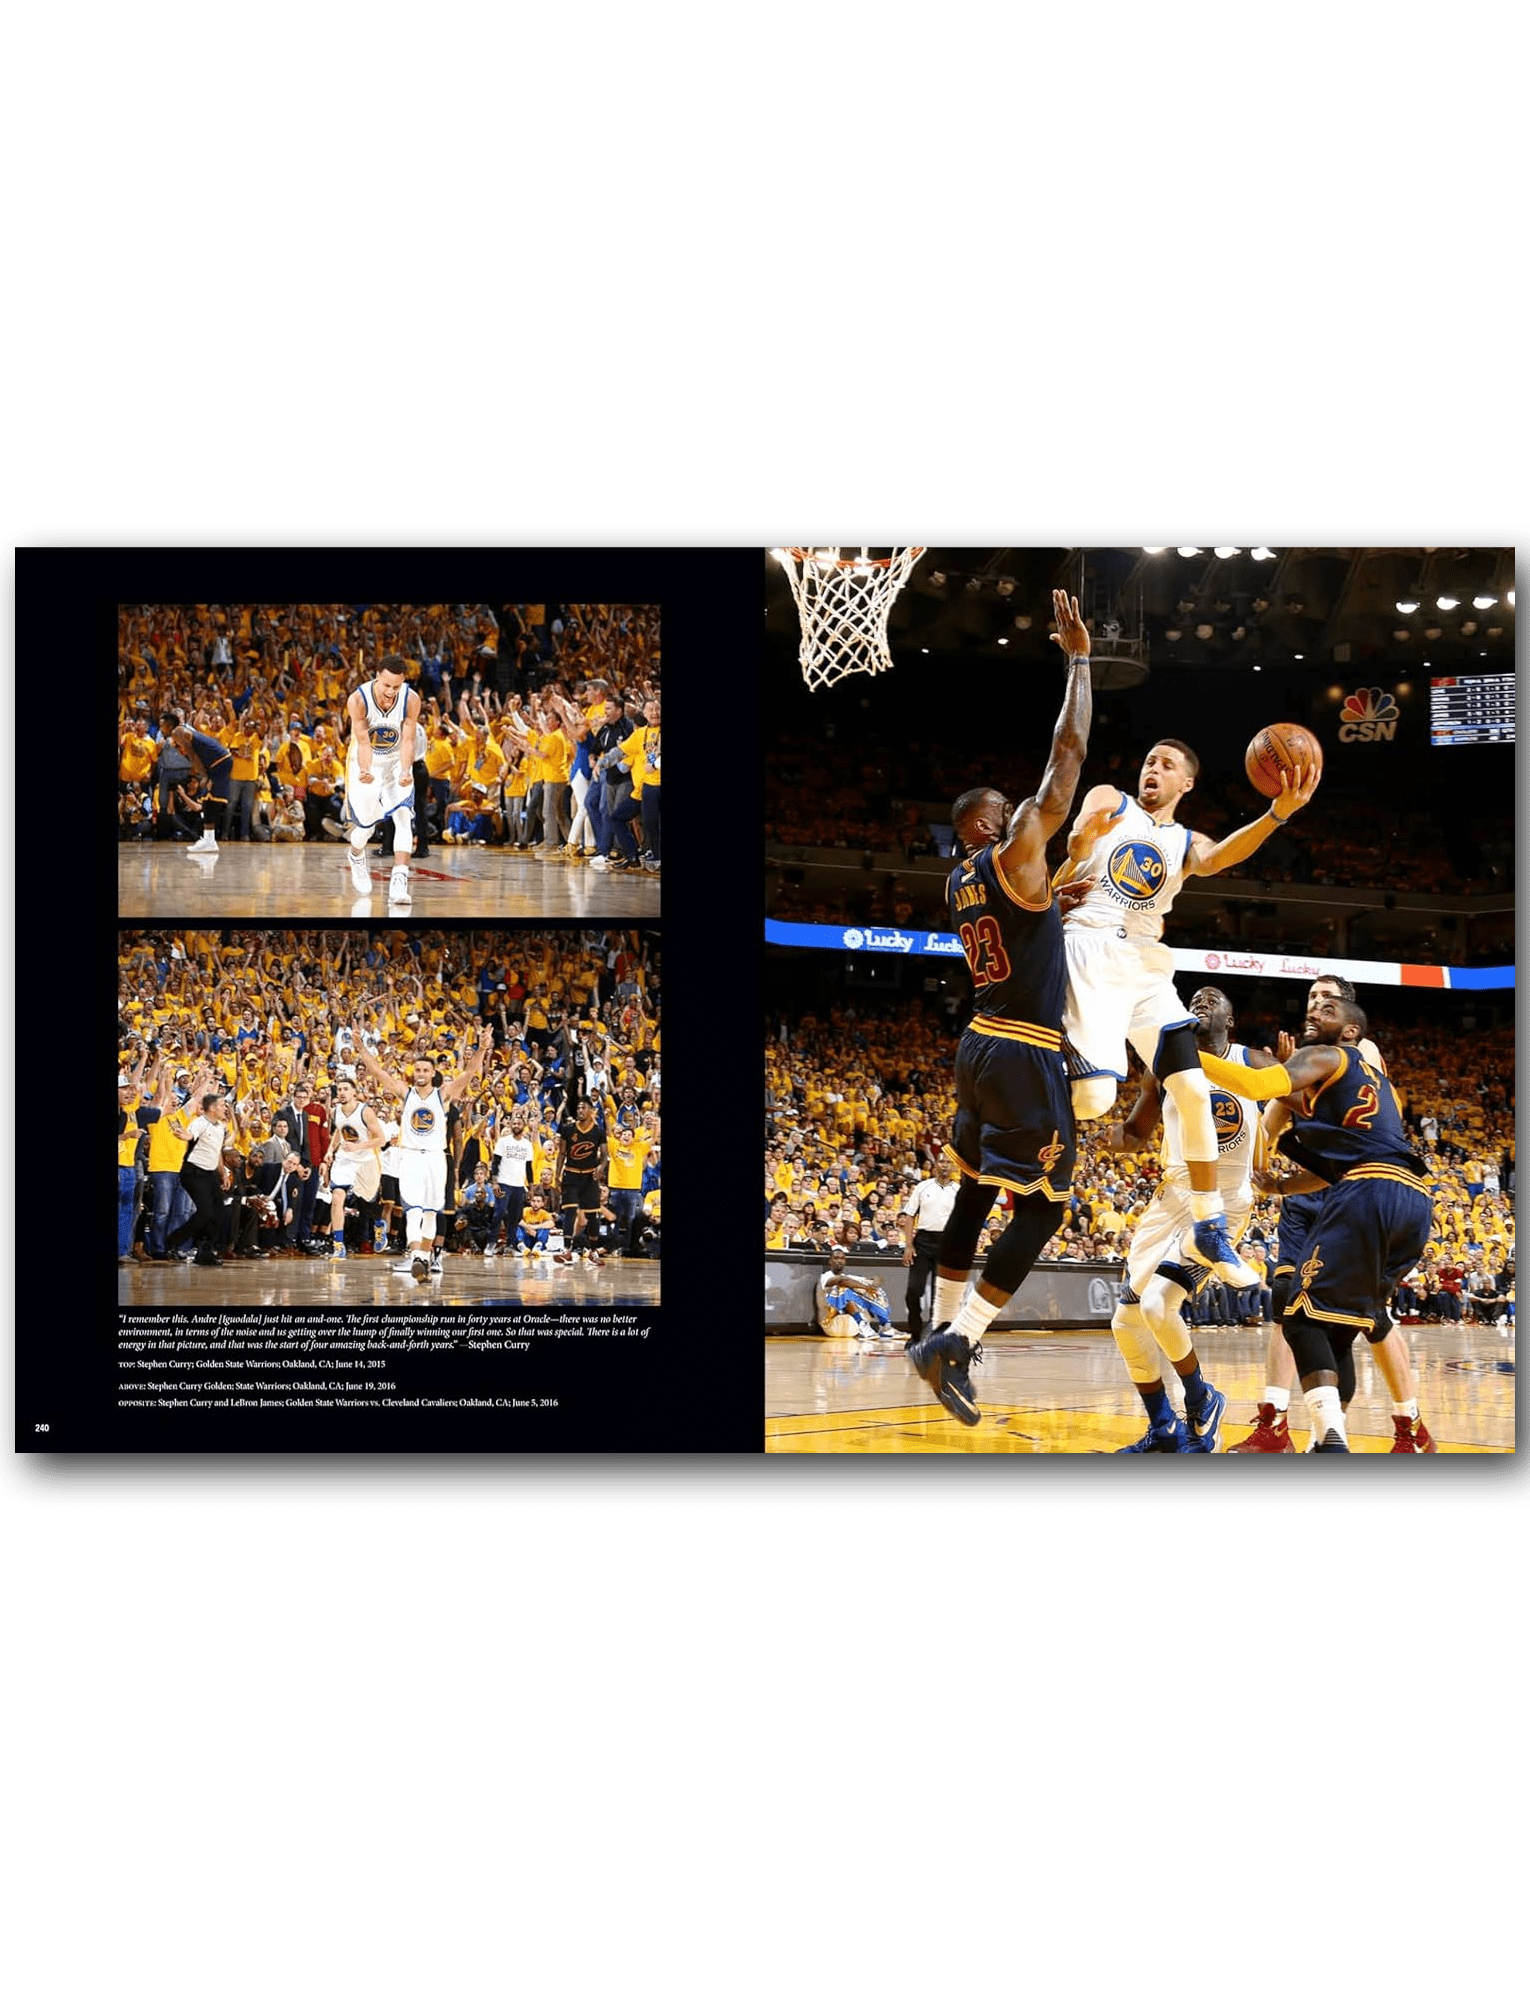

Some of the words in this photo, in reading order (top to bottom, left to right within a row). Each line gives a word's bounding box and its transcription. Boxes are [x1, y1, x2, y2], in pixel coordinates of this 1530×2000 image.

[382, 730, 395, 739] 30
[1338, 721, 1398, 743] CSN
[1139, 856, 1163, 878] 30
[1098, 874, 1156, 912] WARRIORS
[864, 929, 915, 953] Lucky
[923, 933, 964, 953] Luck
[959, 915, 1012, 988] 23
[1223, 953, 1265, 973] Lucky
[1214, 1101, 1237, 1117] 23
[1342, 1083, 1379, 1130] 2
[1217, 1130, 1247, 1154] RIORS
[128, 1314, 170, 1323] remember
[172, 1314, 189, 1323] this.
[191, 1314, 217, 1323] Andre
[262, 1315, 279, 1326] just
[281, 1314, 292, 1323] hit
[307, 1314, 343, 1323] and-one.
[346, 1314, 361, 1323] The
[362, 1314, 379, 1325] first
[381, 1314, 438, 1325] championship
[457, 1315, 466, 1323] in
[467, 1314, 488, 1325] forty
[489, 1317, 511, 1325] years
[613, 1314, 637, 1323] better
[118, 1328, 172, 1336] environment,
[175, 1328, 183, 1336] in
[210, 1327, 220, 1338] of
[220, 1327, 234, 1336] the
[236, 1328, 257, 1336] noise
[259, 1327, 276, 1336] and
[287, 1328, 316, 1338] getting
[338, 1327, 351, 1336] the
[353, 1327, 377, 1338] hump
[379, 1327, 388, 1338] of
[388, 1327, 415, 1338] finally
[417, 1328, 450, 1339] winning
[466, 1327, 484, 1338] first
[505, 1327, 516, 1336] So
[518, 1327, 535, 1336] that
[554, 1327, 584, 1338] special.
[587, 1327, 610, 1336] There
[612, 1328, 618, 1336] is
[628, 1327, 638, 1336] lot
[641, 1327, 651, 1338] of
[118, 1342, 146, 1351] energy
[159, 1340, 175, 1348] that
[177, 1341, 208, 1351] picture,
[210, 1340, 226, 1348] and
[228, 1340, 245, 1348] that
[265, 1340, 278, 1348] the
[301, 1340, 311, 1351] of
[310, 1340, 329, 1350] four
[330, 1341, 366, 1351] amazing
[367, 1340, 429, 1351] back-and-forth
[504, 1340, 530, 1351] Curry
[137, 1360, 167, 1370] Stephen
[196, 1360, 224, 1368] Golden
[225, 1360, 244, 1368] State
[282, 1360, 317, 1368] Oakland,
[335, 1360, 353, 1368] June
[367, 1360, 385, 1368] 2015
[147, 1382, 178, 1392] Stephen
[179, 1382, 202, 1392] Curry
[236, 1382, 254, 1390] State
[292, 1382, 327, 1390] Oakland,
[345, 1382, 363, 1391] June
[364, 1382, 376, 1390] 19,
[377, 1382, 396, 1390] 2016
[158, 1398, 188, 1408] Stephen
[190, 1399, 213, 1408] Curry
[214, 1398, 229, 1406] and
[382, 1398, 419, 1406] Cleveland
[459, 1398, 494, 1407] Oakland,
[512, 1399, 530, 1407] June
[531, 1399, 538, 1407] 5,
[35, 1424, 50, 1432] 240
